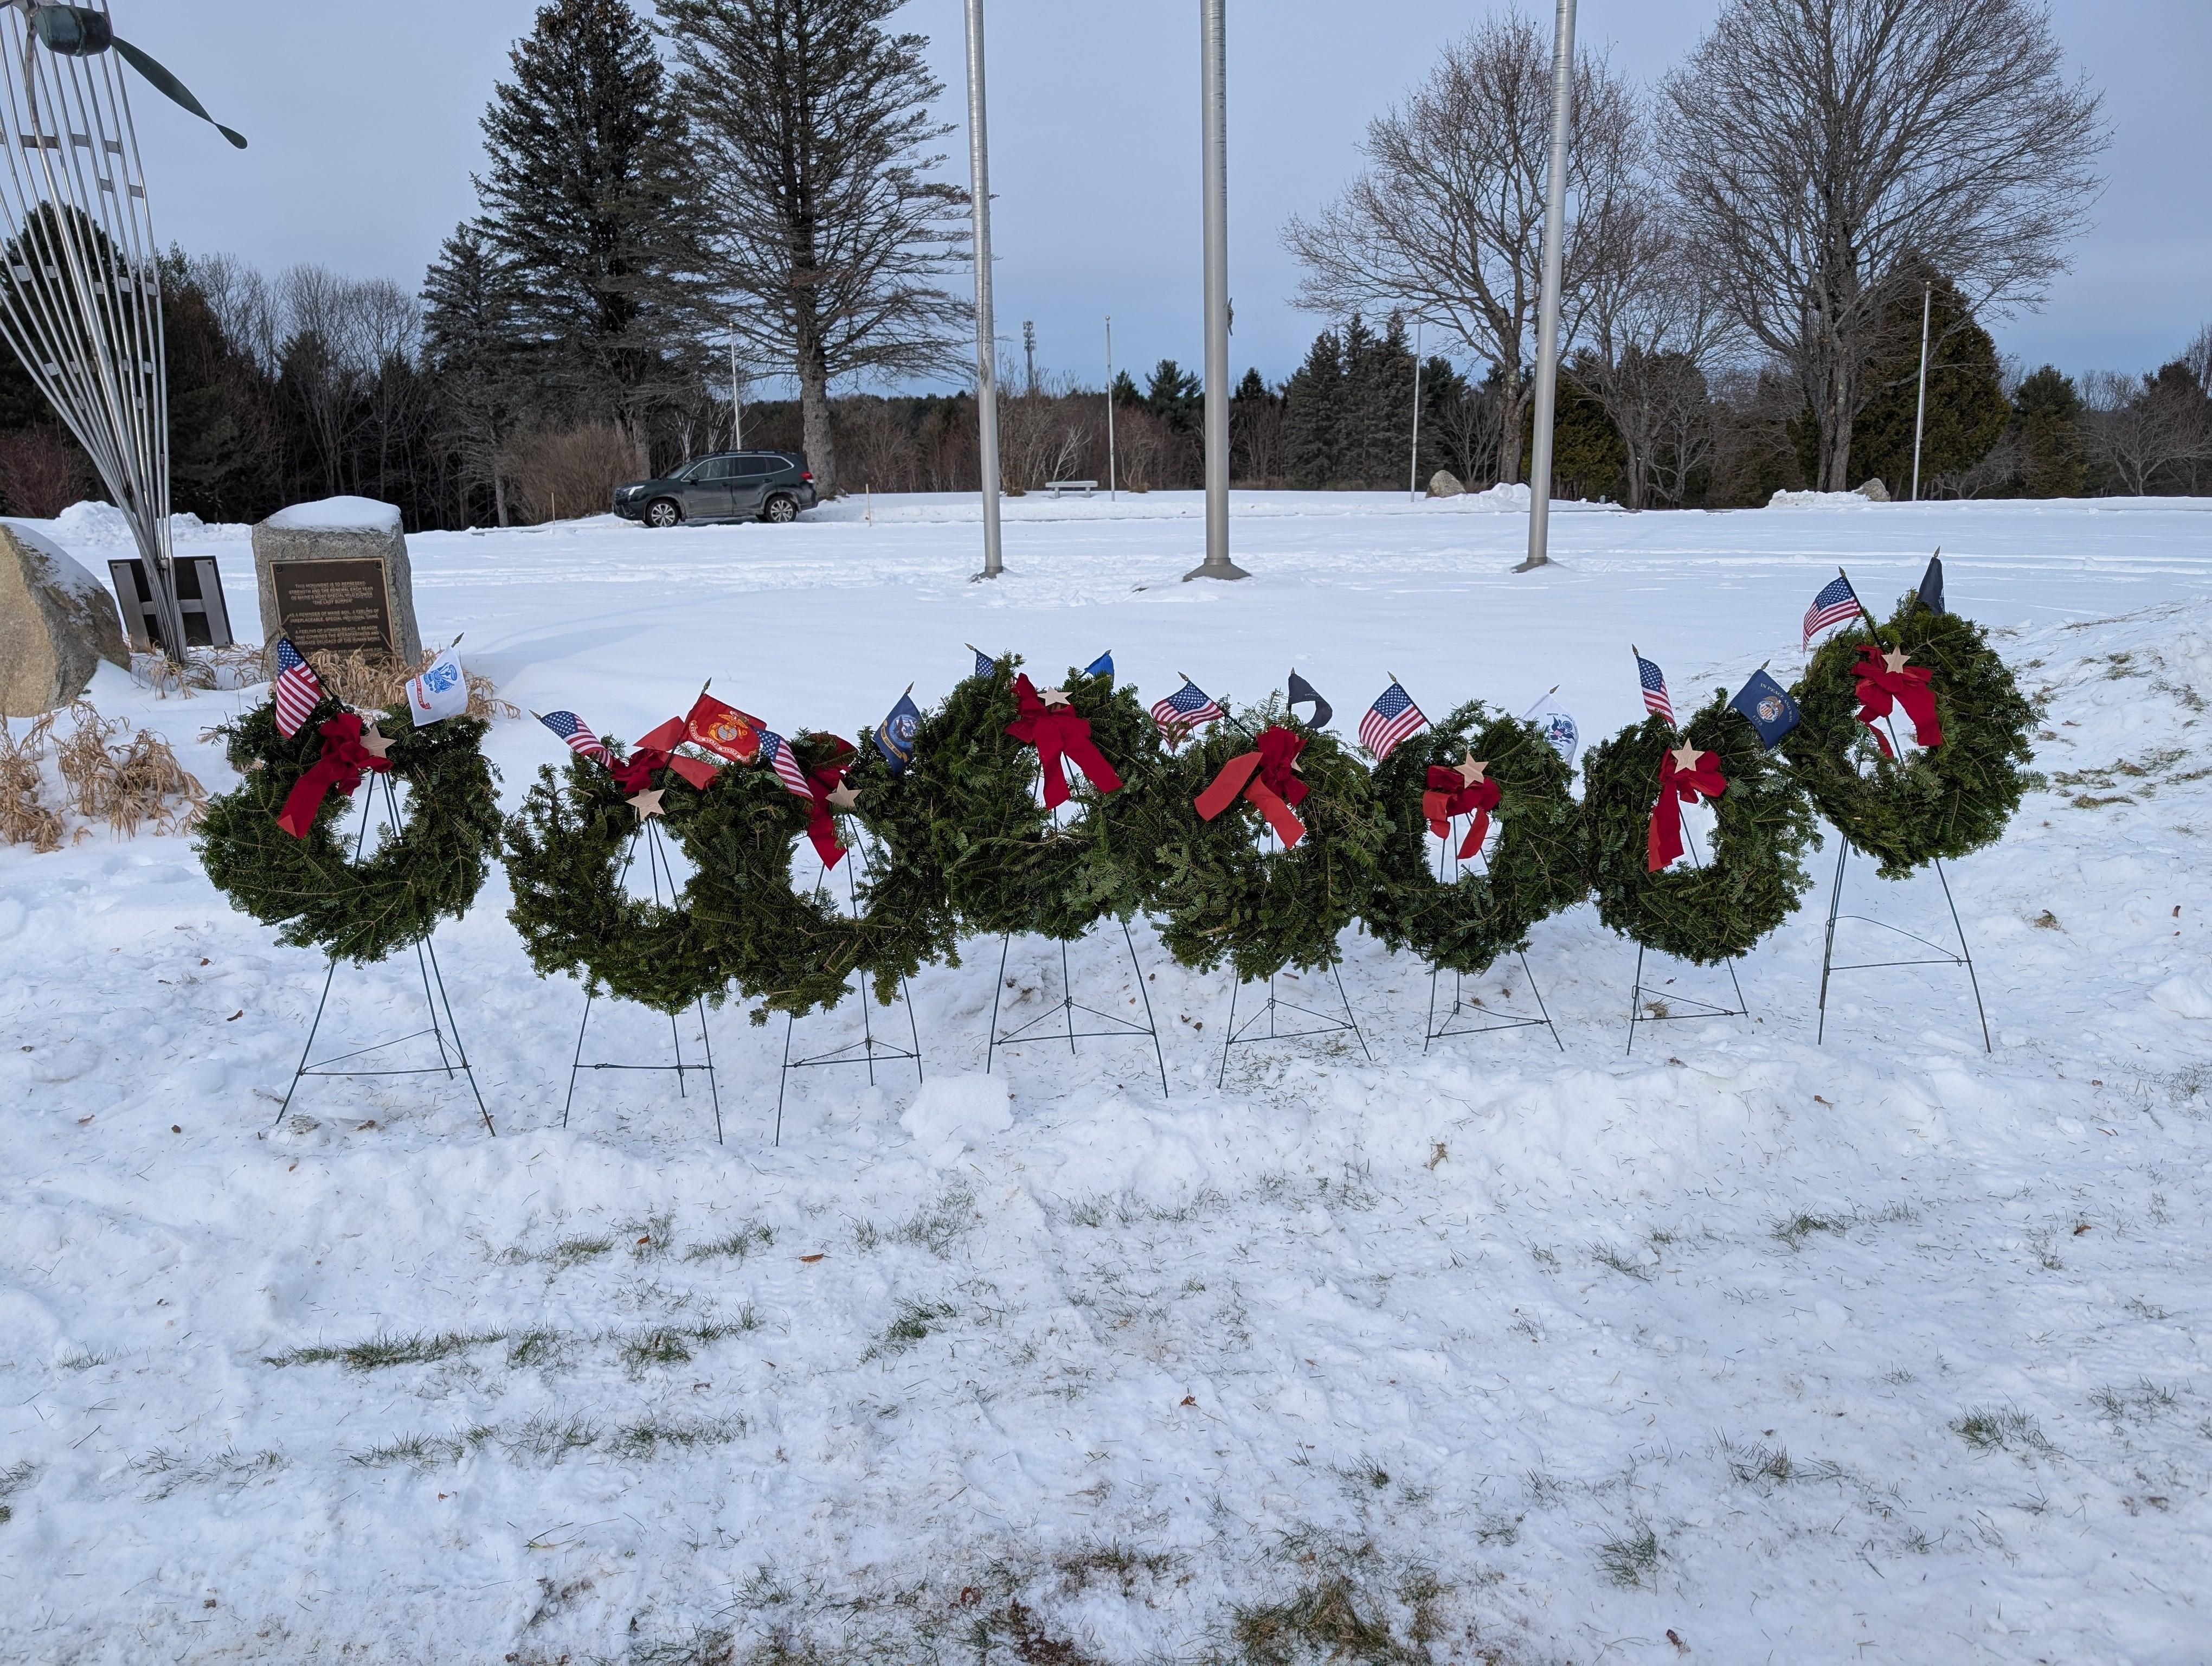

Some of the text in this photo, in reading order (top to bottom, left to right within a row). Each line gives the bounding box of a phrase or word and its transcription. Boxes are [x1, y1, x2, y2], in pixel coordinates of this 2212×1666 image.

[1767, 686, 1785, 699] PEACE
[690, 727, 703, 741] UNITED
[704, 738, 721, 749] STATES
[722, 748, 738, 757] MARINE
[884, 738, 893, 748] STATES
